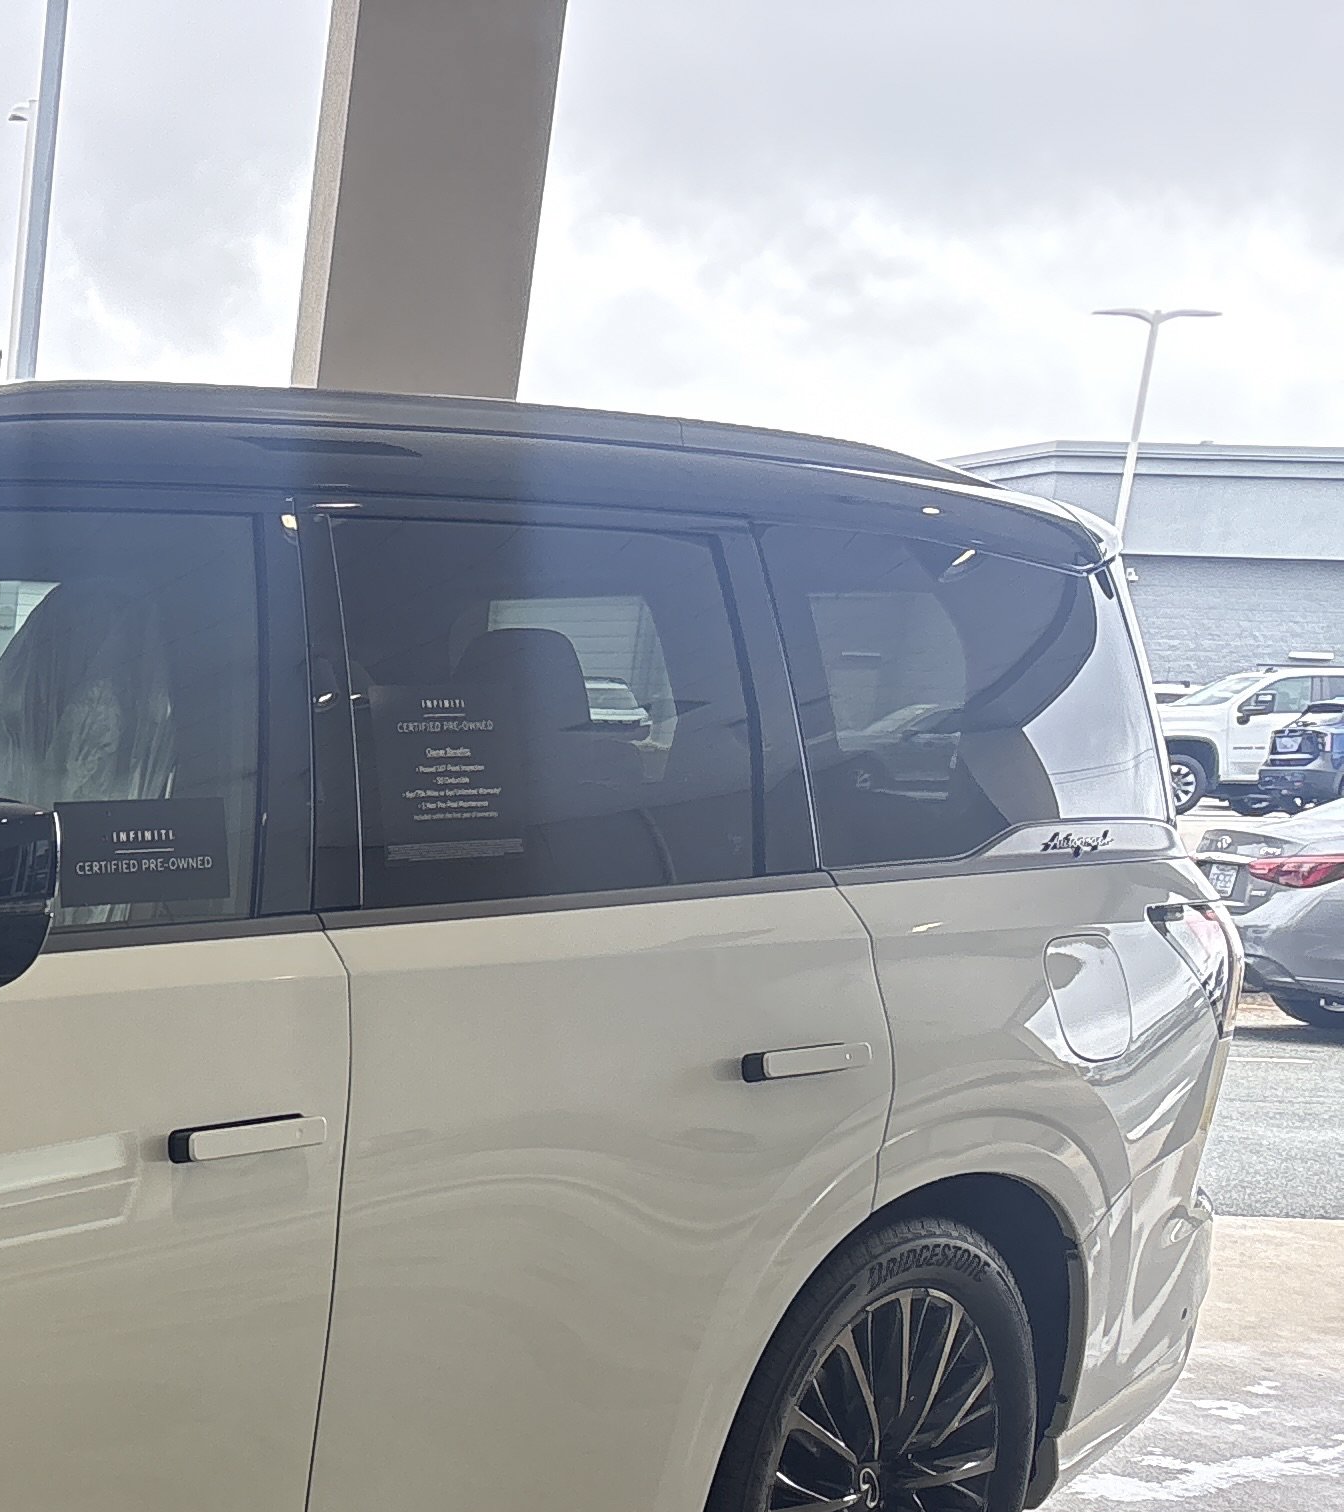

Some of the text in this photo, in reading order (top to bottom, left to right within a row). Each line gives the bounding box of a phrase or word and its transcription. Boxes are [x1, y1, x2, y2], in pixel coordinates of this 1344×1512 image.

[397, 719, 494, 733] CERTIFIED PRE-OWNED
[113, 829, 176, 843] INFINITI
[76, 856, 213, 875] CERTIFIED PRE-OWNED
[866, 1243, 991, 1295] BRIDGESTONE
